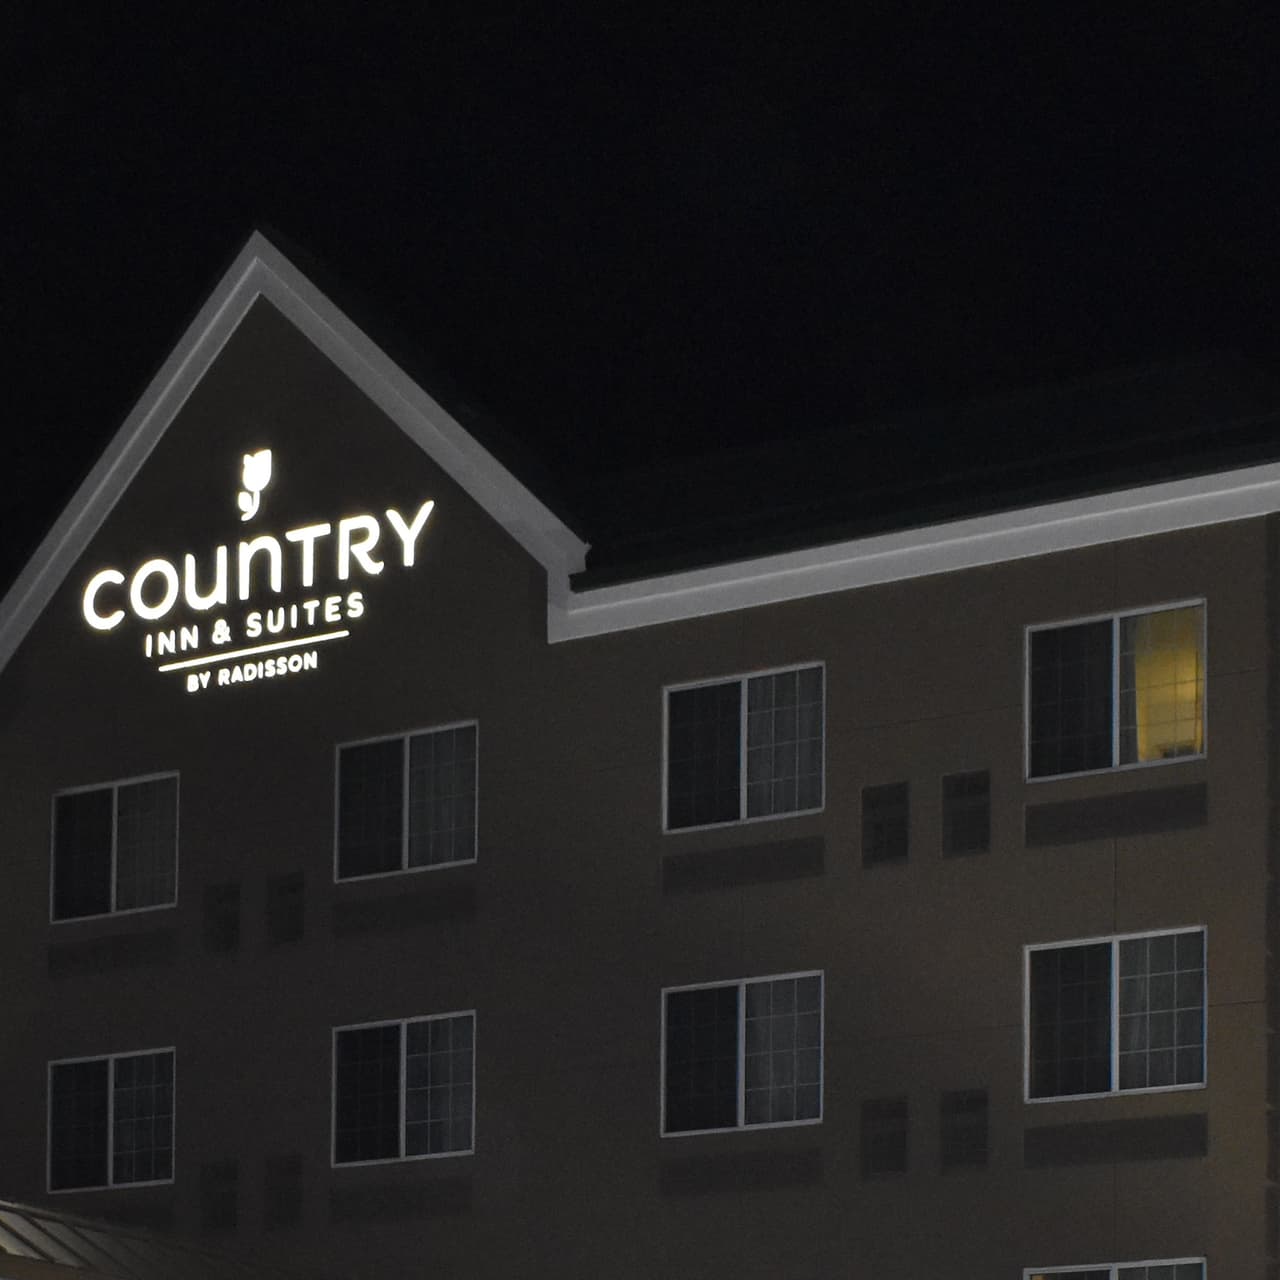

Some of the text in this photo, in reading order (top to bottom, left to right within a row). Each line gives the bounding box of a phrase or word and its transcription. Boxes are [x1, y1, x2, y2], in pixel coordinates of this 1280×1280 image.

[144, 591, 365, 658] INN & SUITES
[186, 650, 318, 693] BY RADISSON
